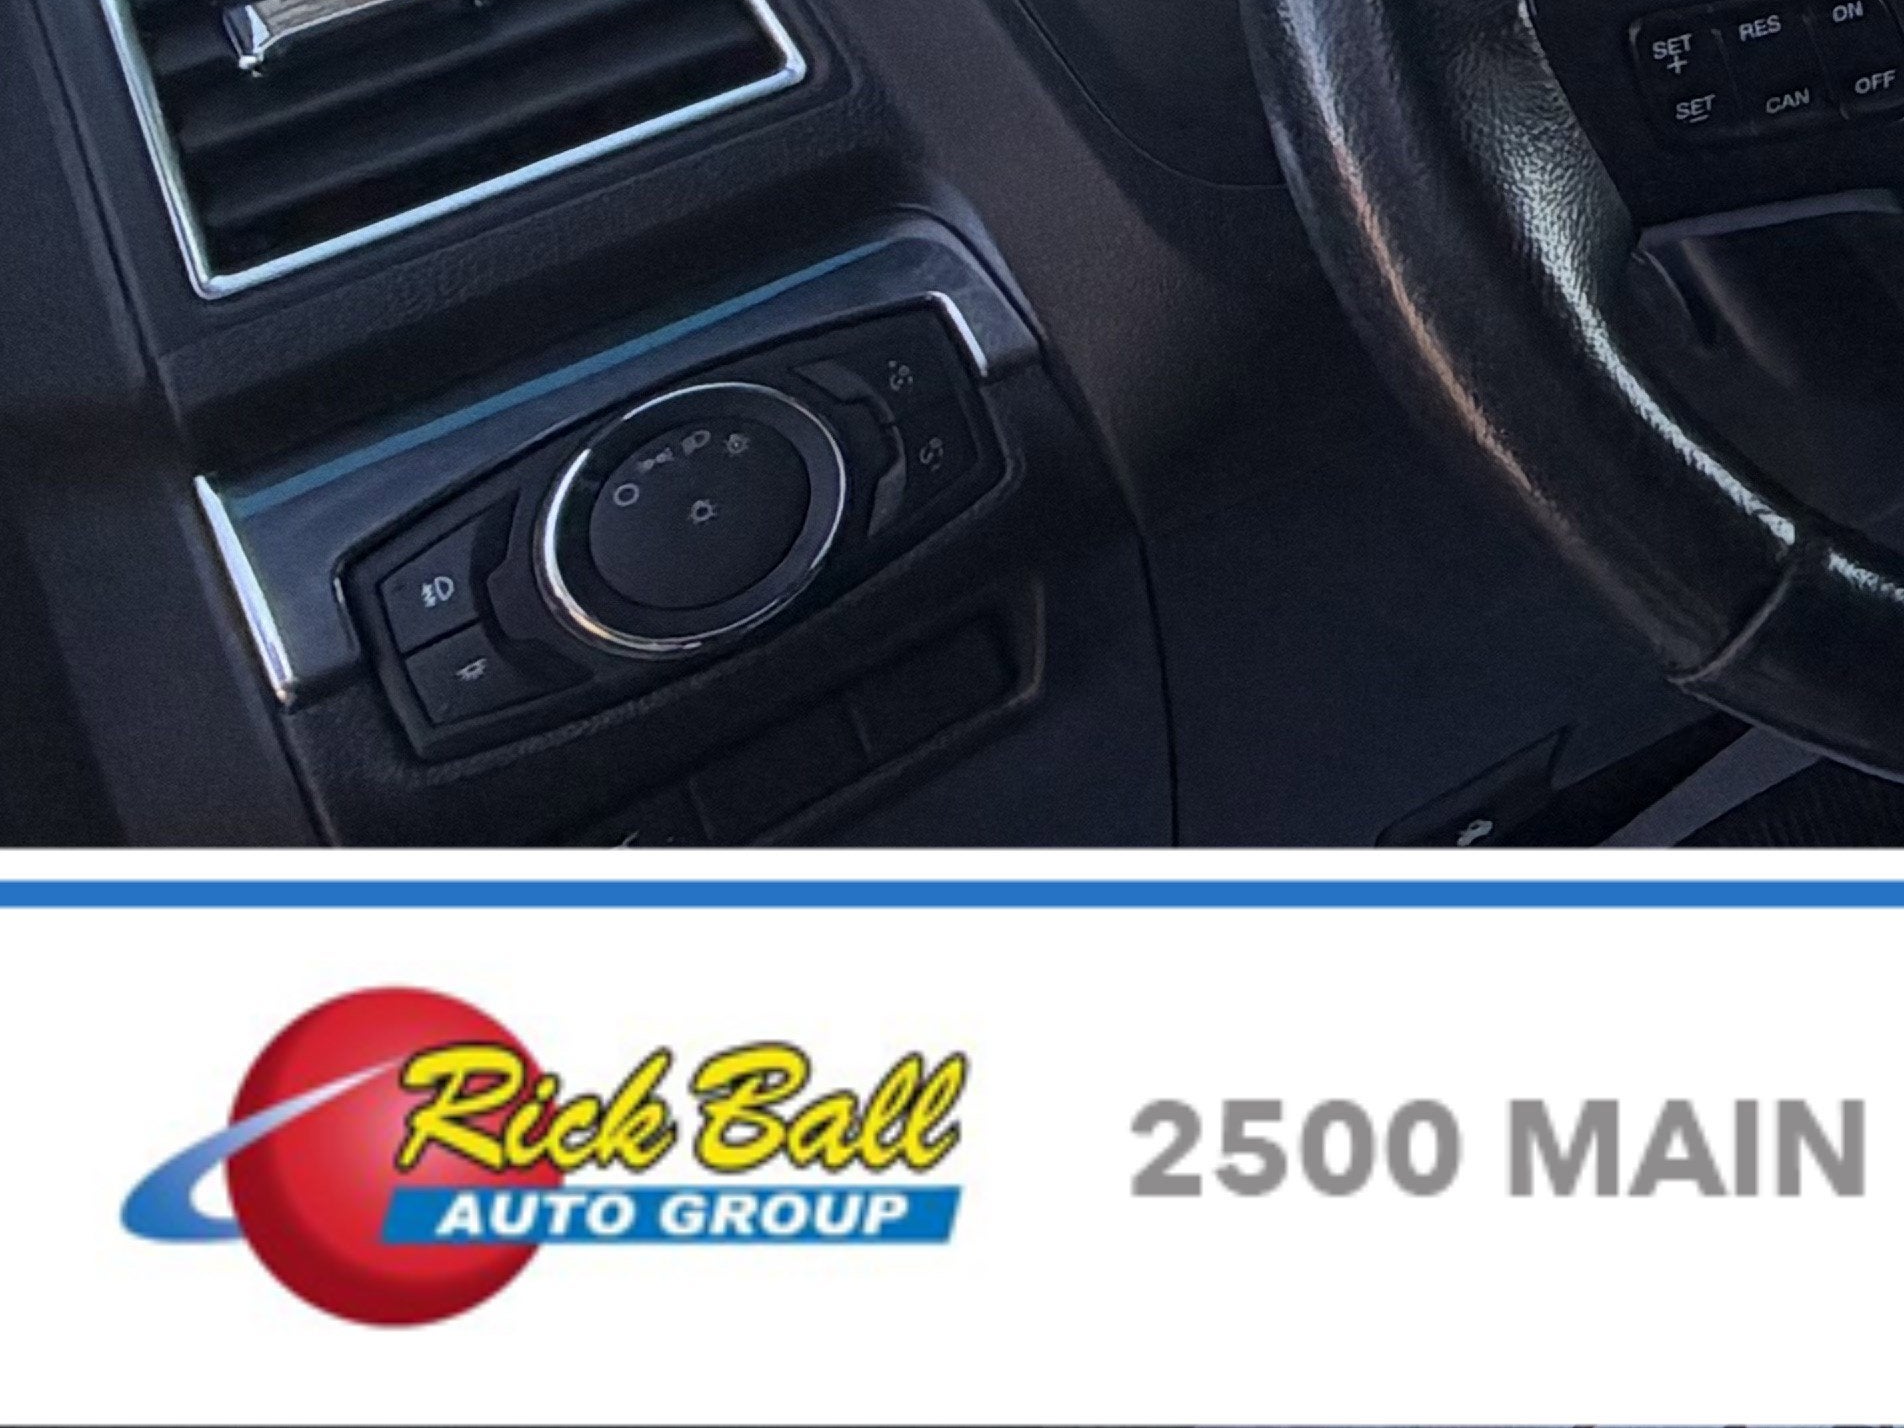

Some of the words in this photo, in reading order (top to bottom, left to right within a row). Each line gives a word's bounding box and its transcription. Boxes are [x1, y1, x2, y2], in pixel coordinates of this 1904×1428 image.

[1831, 0, 1865, 24] ON
[1737, 13, 1783, 42] RES
[1651, 32, 1693, 61] SET
[1853, 67, 1897, 95] OFF
[1674, 92, 1717, 121] SET
[1764, 87, 1812, 115] CAN
